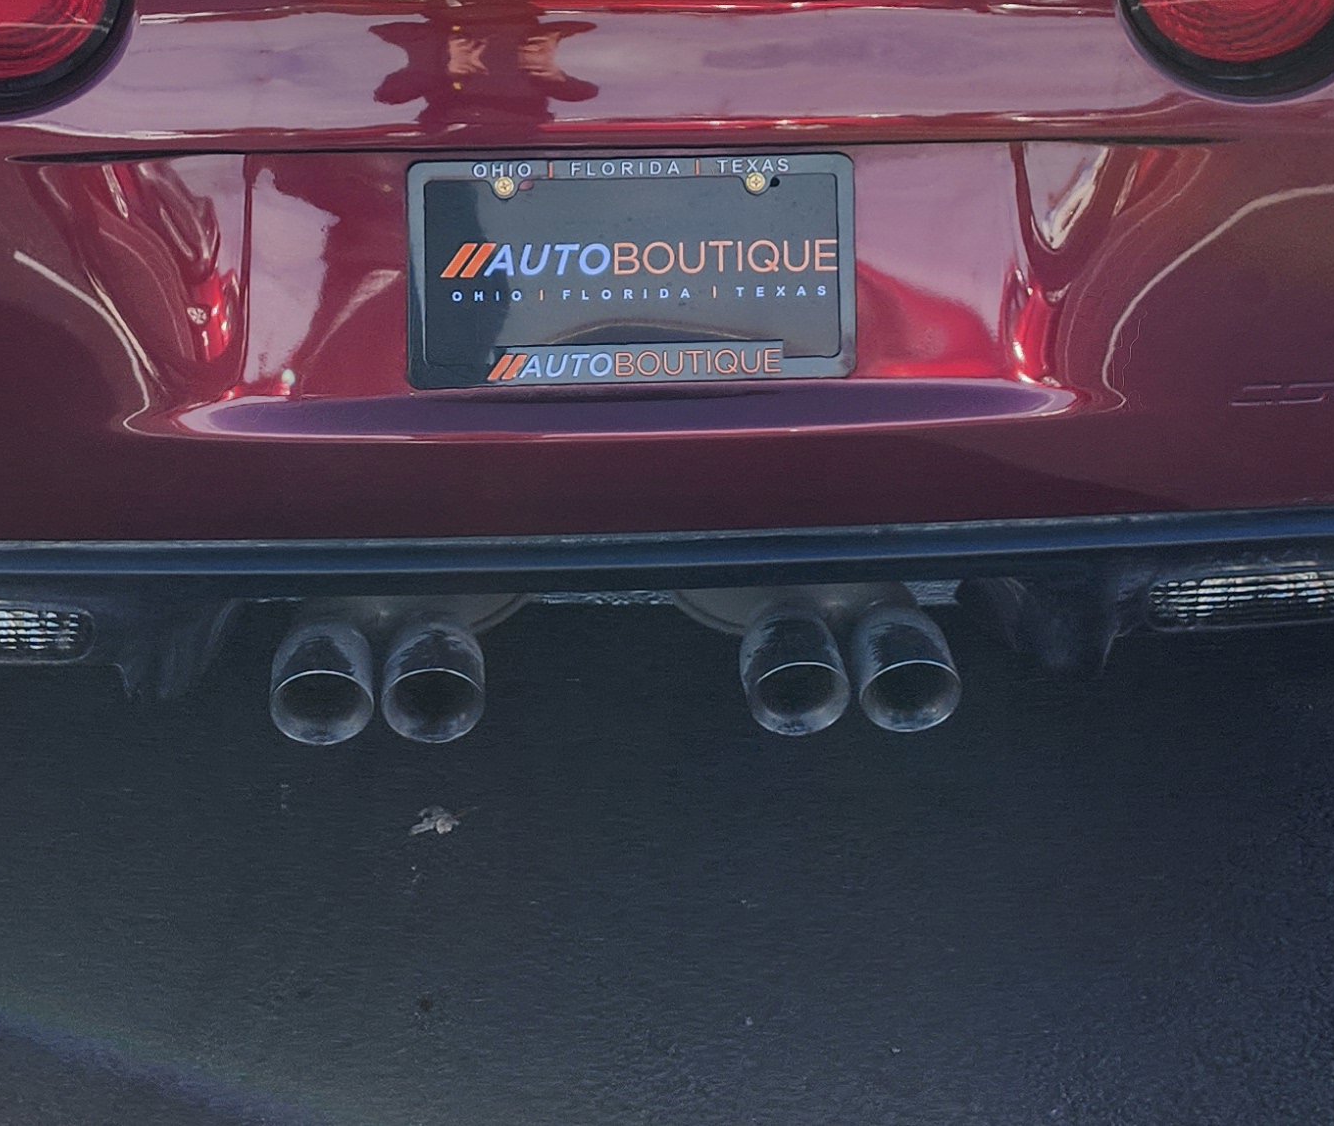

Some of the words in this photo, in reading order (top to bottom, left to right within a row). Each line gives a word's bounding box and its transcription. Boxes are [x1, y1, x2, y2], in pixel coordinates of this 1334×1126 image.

[471, 162, 532, 178] OHIO
[570, 160, 681, 176] FLORIDA
[717, 158, 790, 174] TEXAS
[483, 238, 838, 276] AUTOBOUTIQUE
[451, 289, 522, 302] OHIO
[562, 288, 691, 302] FLORIDA
[735, 285, 828, 299] TEXAS
[518, 348, 783, 378] AUTOBOUTIQUE
